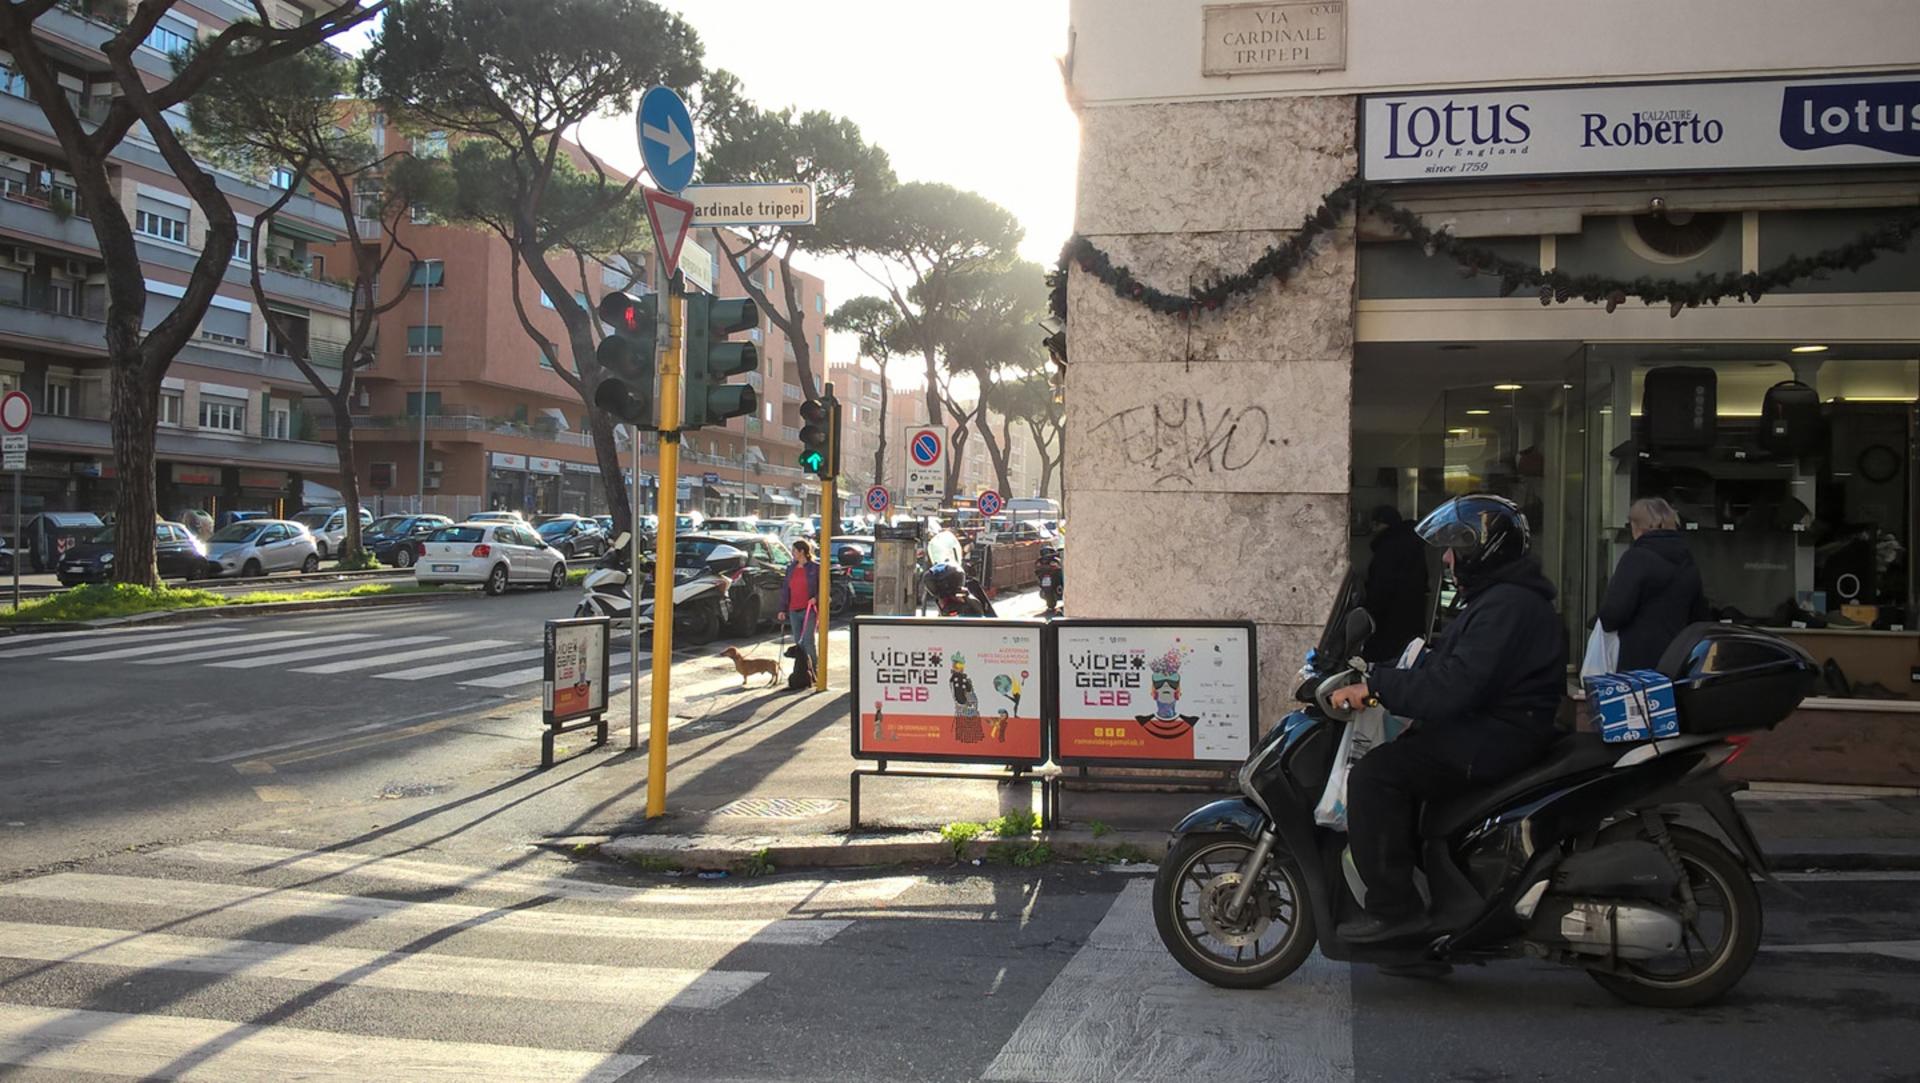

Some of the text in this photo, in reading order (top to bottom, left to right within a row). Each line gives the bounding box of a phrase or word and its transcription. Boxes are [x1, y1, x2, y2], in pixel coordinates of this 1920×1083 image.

[1255, 11, 1288, 25] VIA
[1223, 27, 1327, 46] CARDINALE
[1233, 47, 1310, 64] TRIPEPI
[1641, 110, 1692, 121] CALZATURE
[1384, 100, 1531, 159] Lotus
[1580, 112, 1724, 148] Roberto
[1425, 146, 1530, 159] Of England
[1425, 161, 1489, 174] since 1759
[790, 187, 804, 195] via
[695, 200, 804, 219] ardinale tripepi
